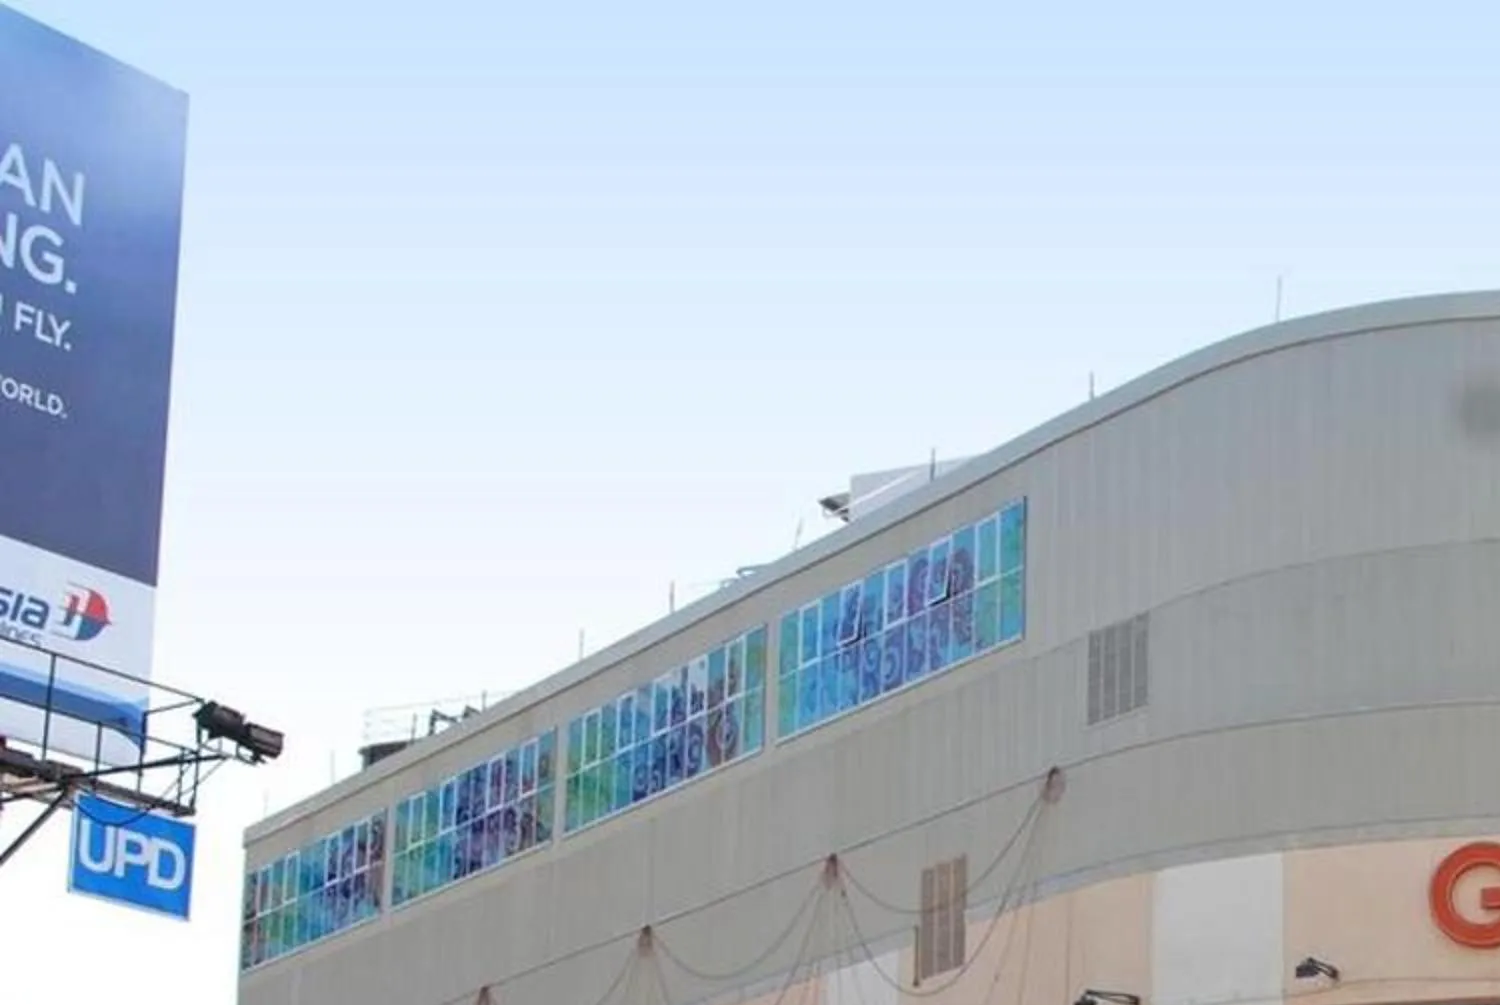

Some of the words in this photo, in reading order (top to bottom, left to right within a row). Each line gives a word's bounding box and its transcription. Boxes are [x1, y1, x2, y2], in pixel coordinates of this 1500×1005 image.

[14, 301, 72, 352] FLY.
[0, 374, 69, 420] ORLD.
[78, 817, 187, 892] UPD
